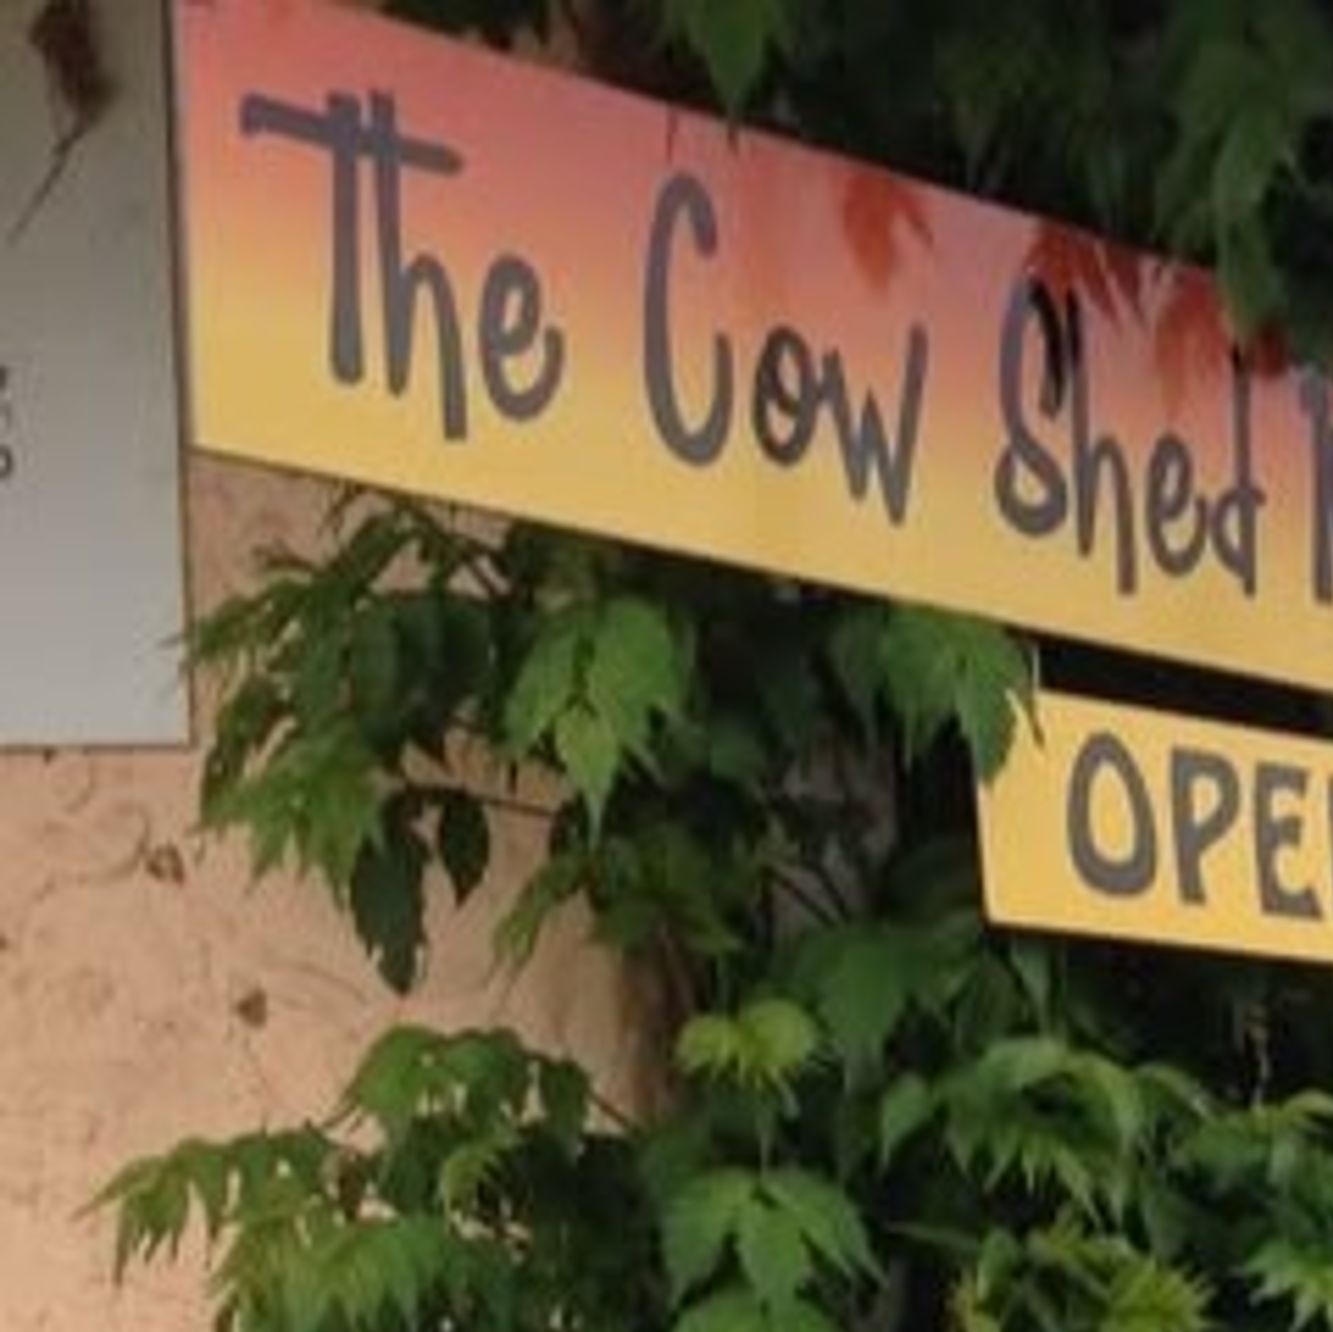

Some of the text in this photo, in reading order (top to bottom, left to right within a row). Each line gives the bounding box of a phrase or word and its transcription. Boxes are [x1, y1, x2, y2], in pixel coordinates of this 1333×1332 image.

[240, 88, 565, 443] The
[642, 170, 929, 527] Cow
[994, 277, 1265, 596] Shed
